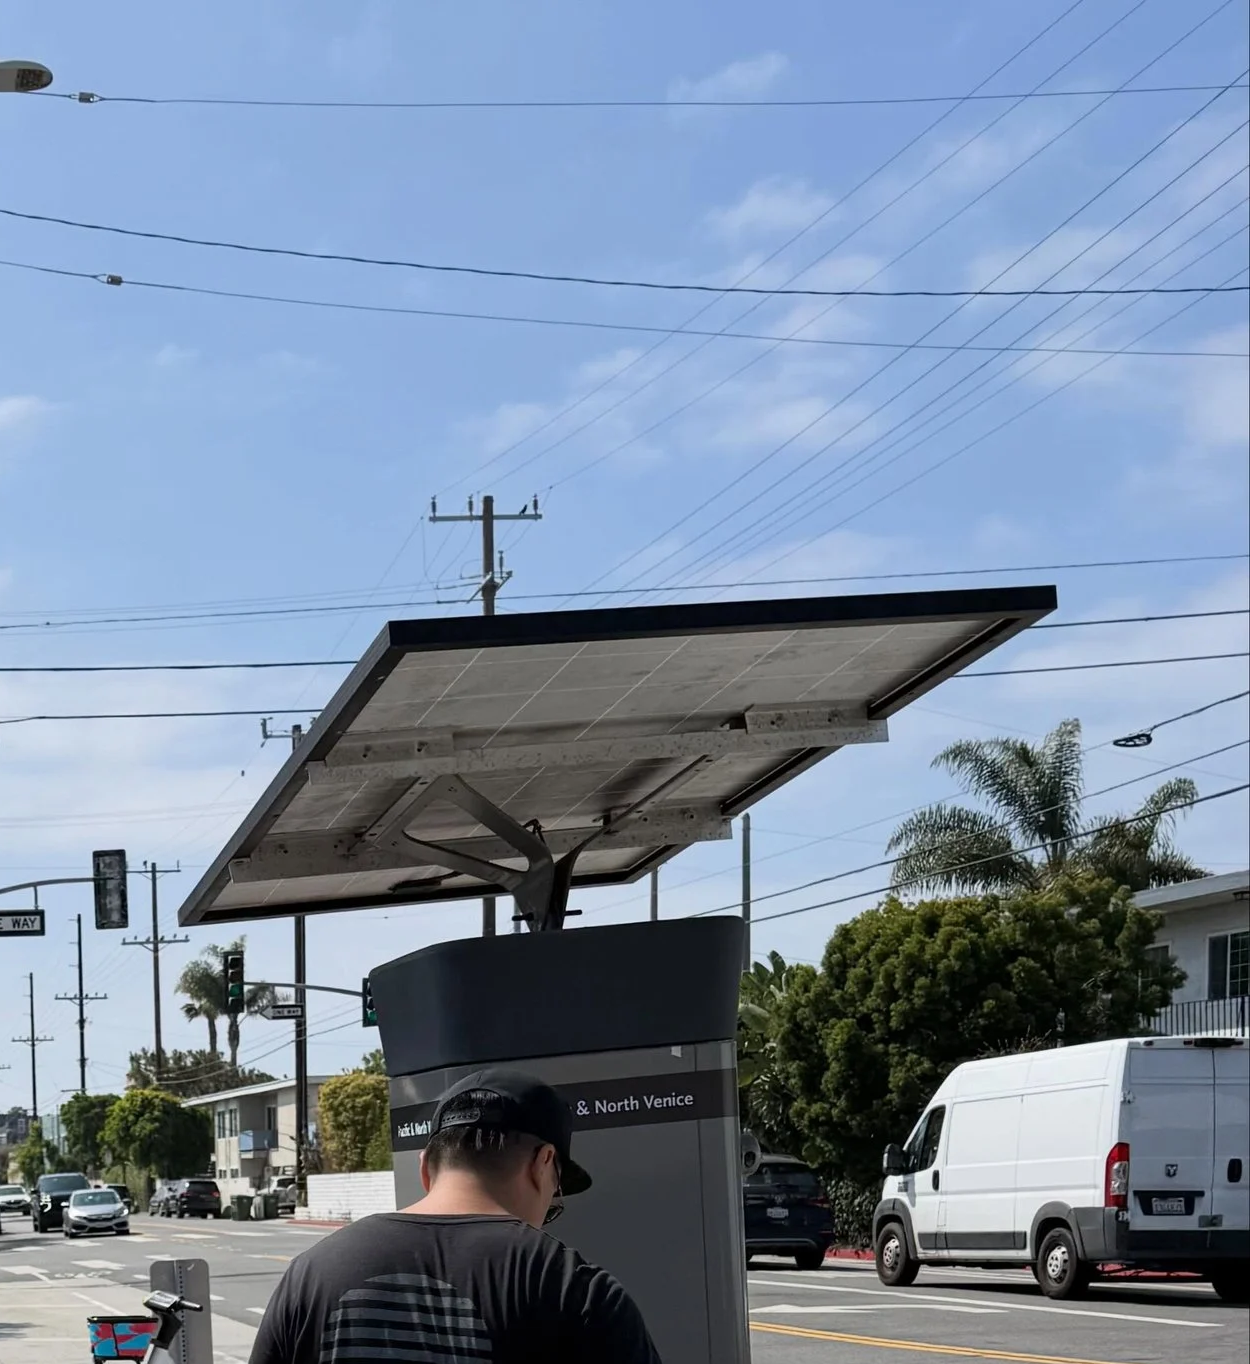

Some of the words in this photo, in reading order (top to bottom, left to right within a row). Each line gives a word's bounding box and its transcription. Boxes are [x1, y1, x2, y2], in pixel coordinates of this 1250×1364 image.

[11, 917, 37, 929] WAY
[576, 1100, 590, 1115] &
[595, 1096, 639, 1114] North
[643, 1092, 694, 1109] Venice
